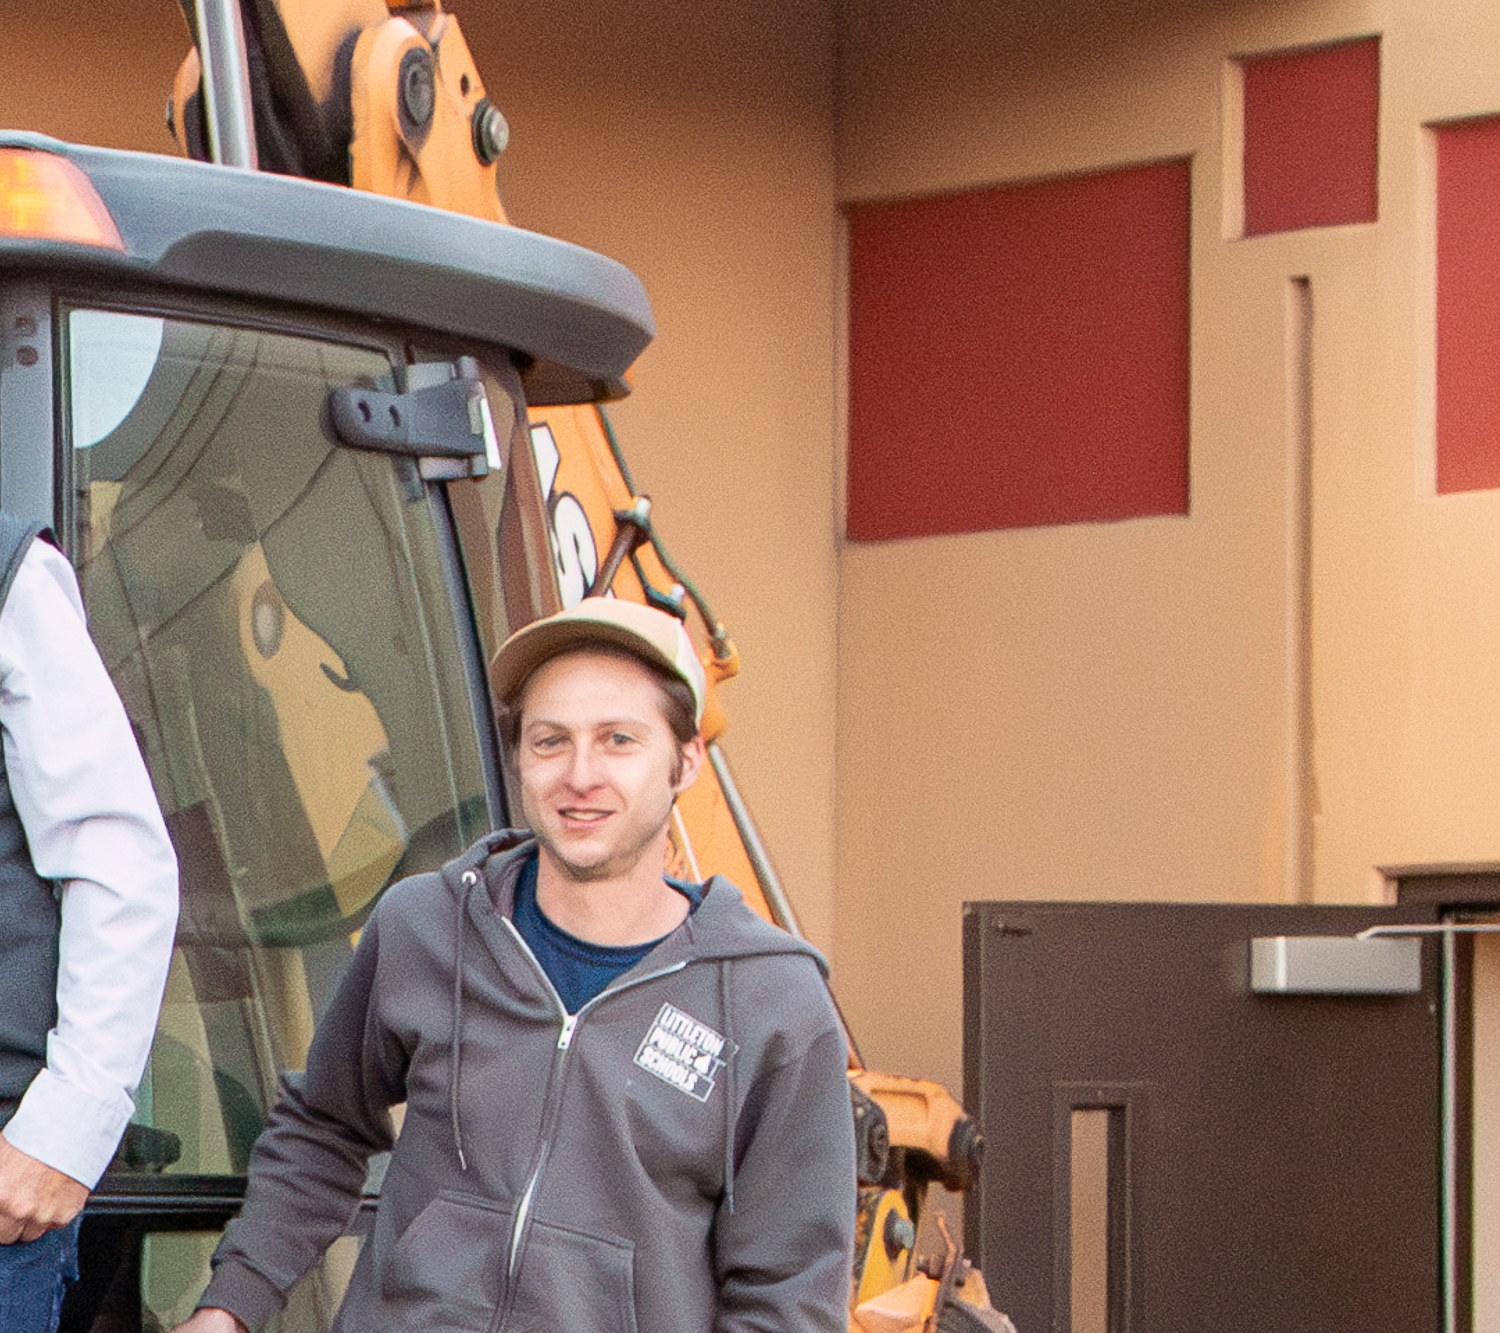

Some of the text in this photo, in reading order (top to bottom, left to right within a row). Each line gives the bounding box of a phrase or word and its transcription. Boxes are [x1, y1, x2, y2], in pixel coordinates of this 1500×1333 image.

[649, 1026, 699, 1066] PUBLIC
[660, 1006, 725, 1057] LITTLETON
[639, 1045, 699, 1092] SCHOOLS
